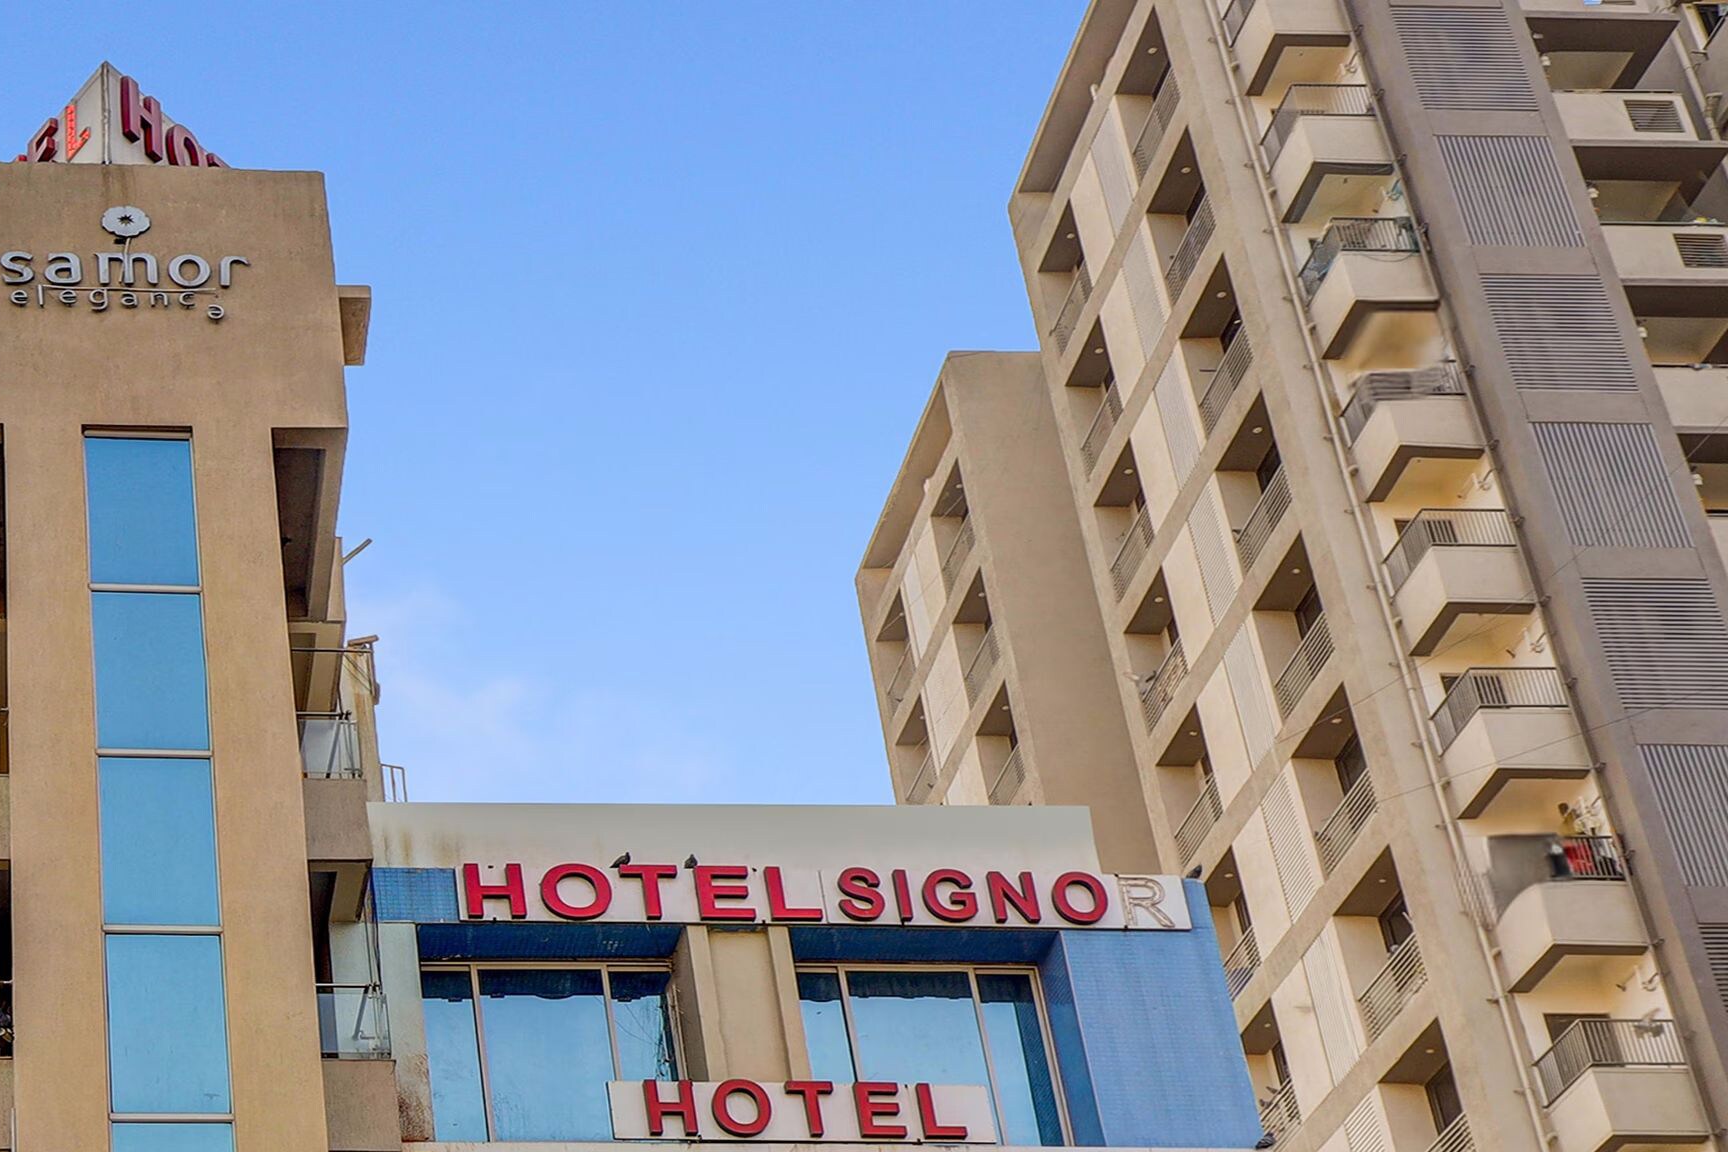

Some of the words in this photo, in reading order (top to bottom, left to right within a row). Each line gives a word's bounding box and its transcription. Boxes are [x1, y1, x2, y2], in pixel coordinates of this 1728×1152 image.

[16, 103, 91, 163] EL
[120, 75, 233, 167] HO
[0, 250, 251, 288] samor
[10, 284, 225, 322] elegance
[462, 861, 823, 924] HOTEL
[837, 867, 1167, 931] SIGNOR
[641, 1078, 969, 1142] HOTEL
